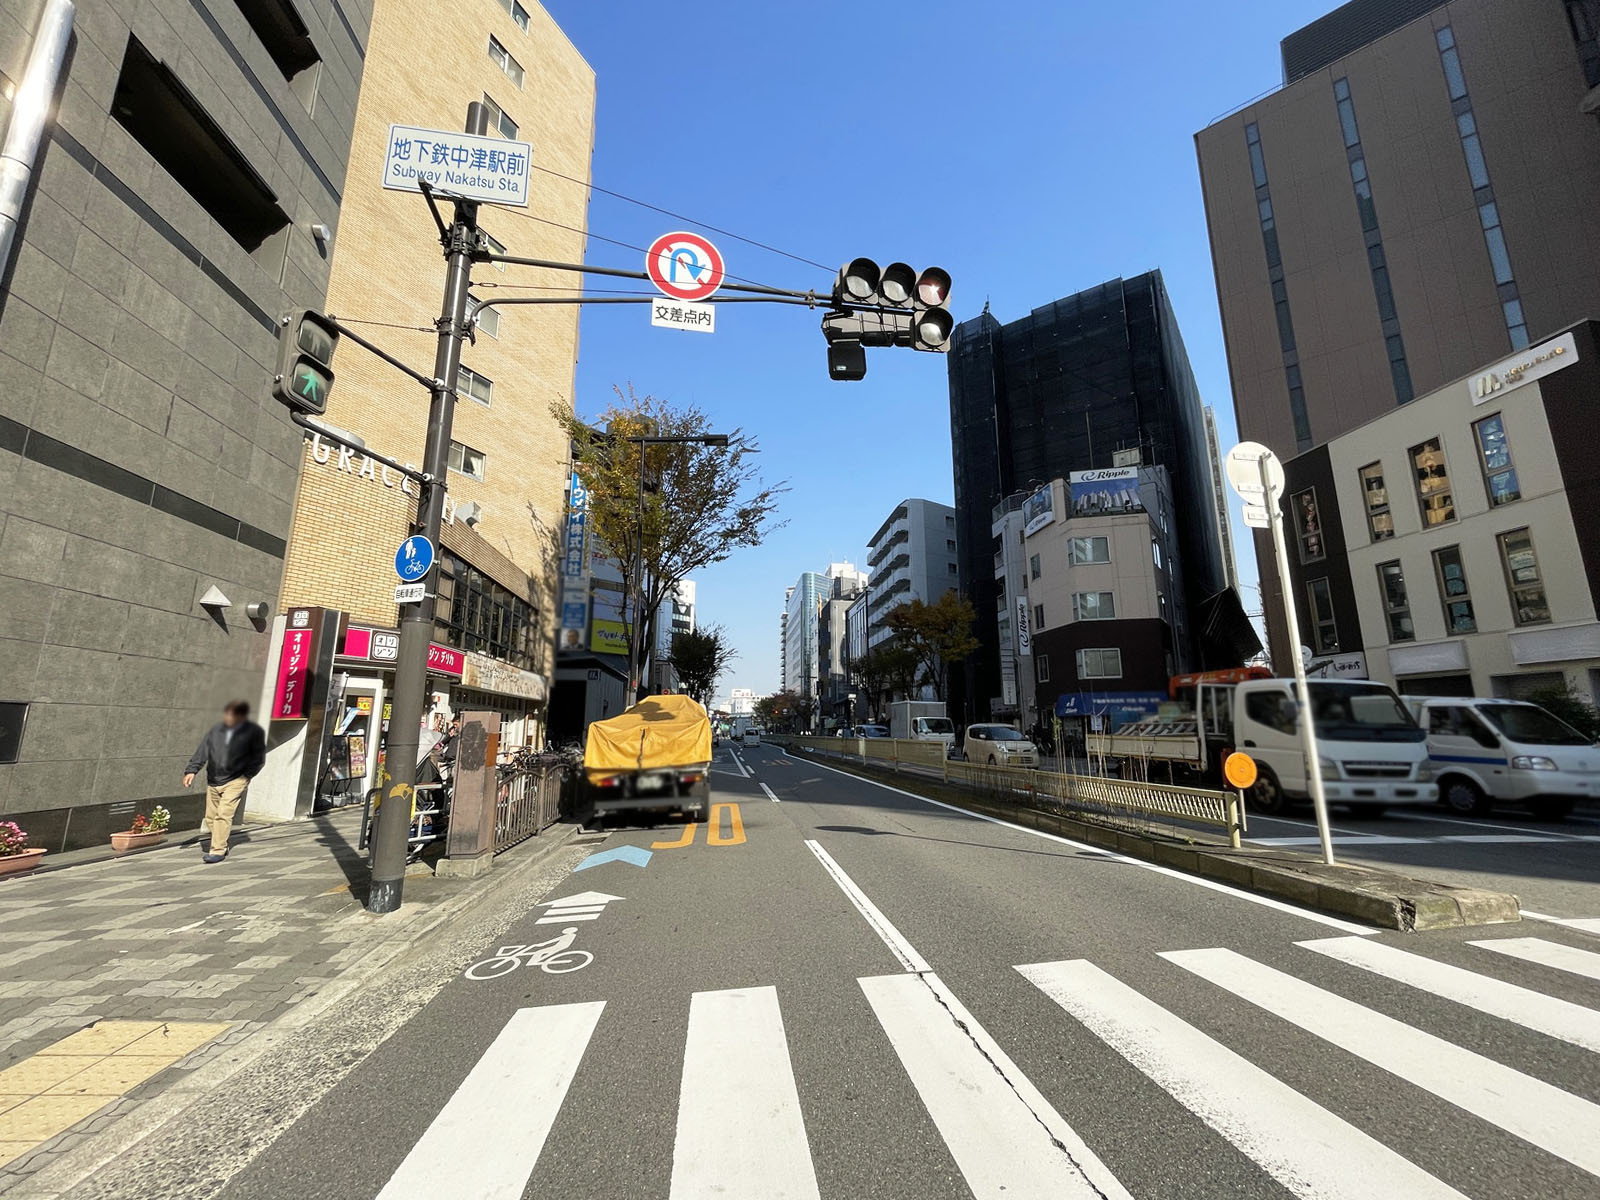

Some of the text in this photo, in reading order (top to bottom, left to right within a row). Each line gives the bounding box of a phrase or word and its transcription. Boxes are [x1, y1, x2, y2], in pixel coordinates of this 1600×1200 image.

[392, 137, 526, 177] 地下鉄中津駅前
[392, 163, 441, 184] Subway
[445, 170, 495, 189] Nakatsu
[655, 305, 711, 326] 交差点内
[312, 432, 418, 494] GRACE
[1097, 470, 1130, 480] Ripple
[440, 651, 455, 666] デリカ
[282, 632, 303, 714] オリジン デリカ
